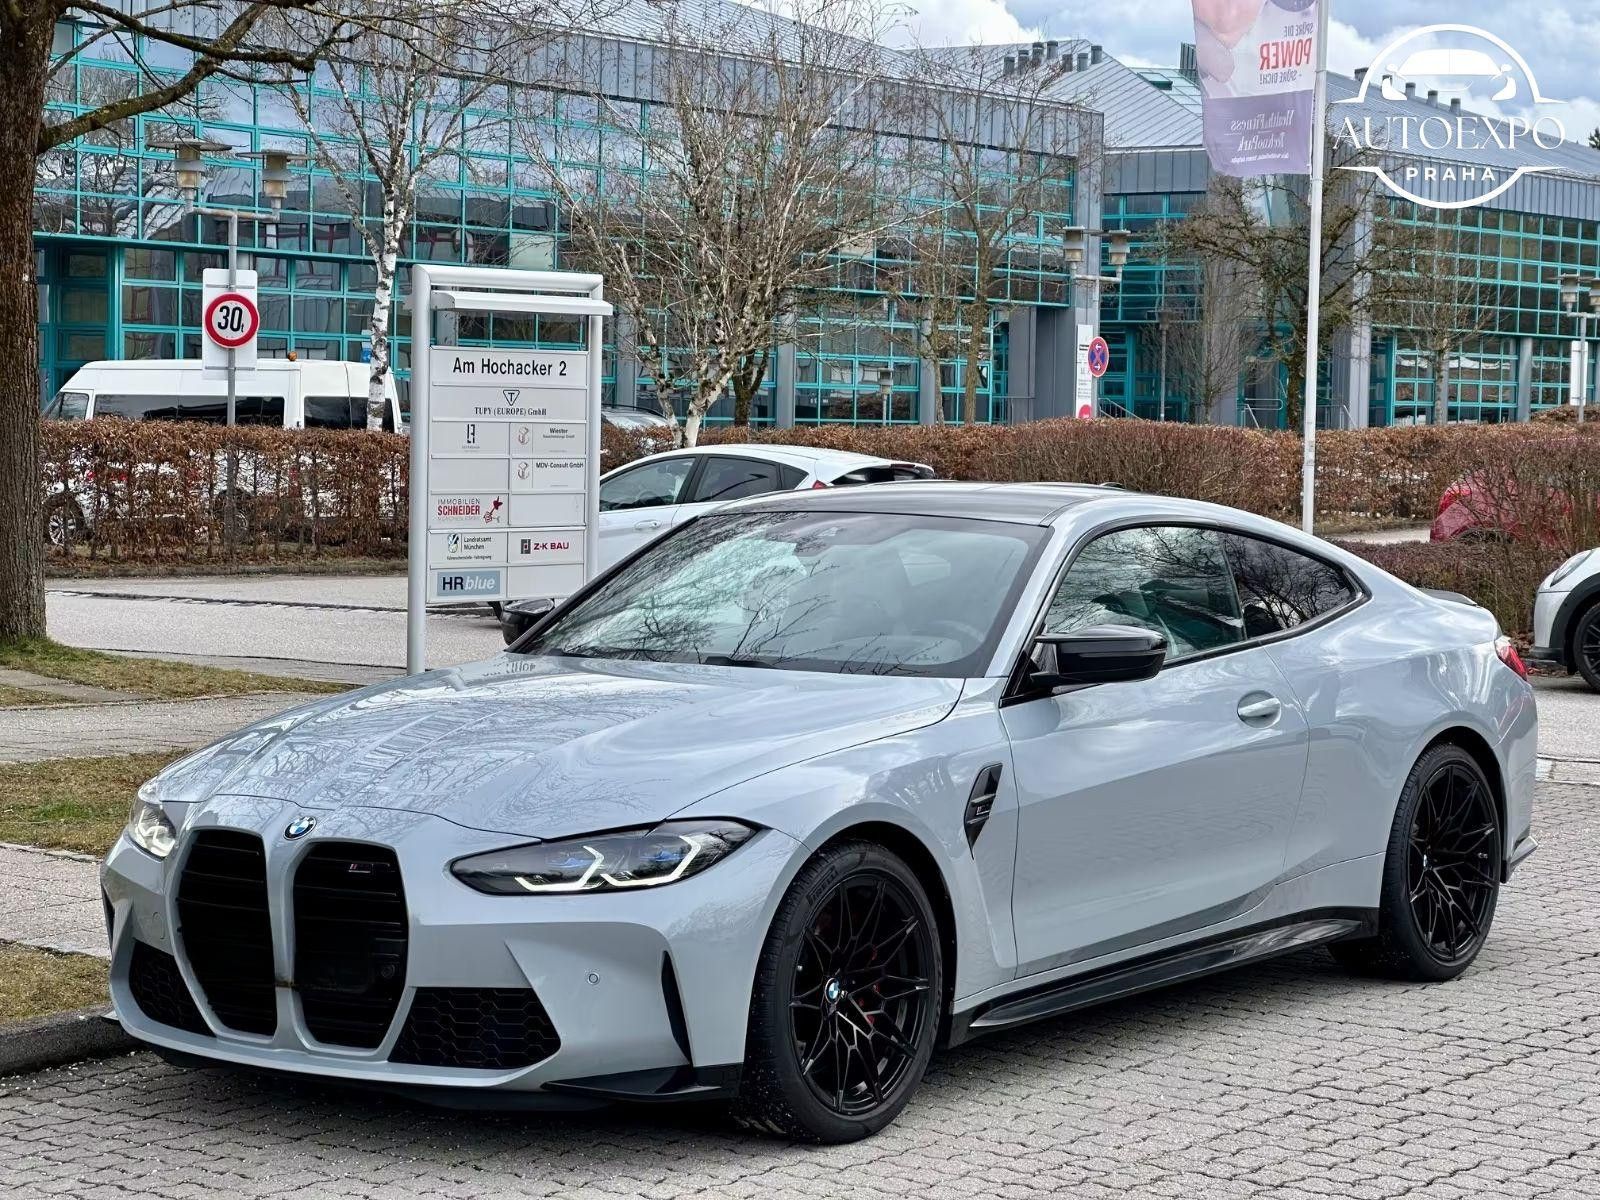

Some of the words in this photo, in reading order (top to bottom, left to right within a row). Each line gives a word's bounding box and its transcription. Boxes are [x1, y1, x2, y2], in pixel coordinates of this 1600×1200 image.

[453, 357, 475, 373] Am
[481, 358, 553, 376] Hochacker
[558, 360, 567, 376] 2
[475, 406, 492, 415] TUPY
[493, 407, 527, 416] (EUROPE)
[527, 408, 547, 416] GmbH
[437, 505, 481, 516] SCHNEIDER
[550, 542, 570, 550] BAU
